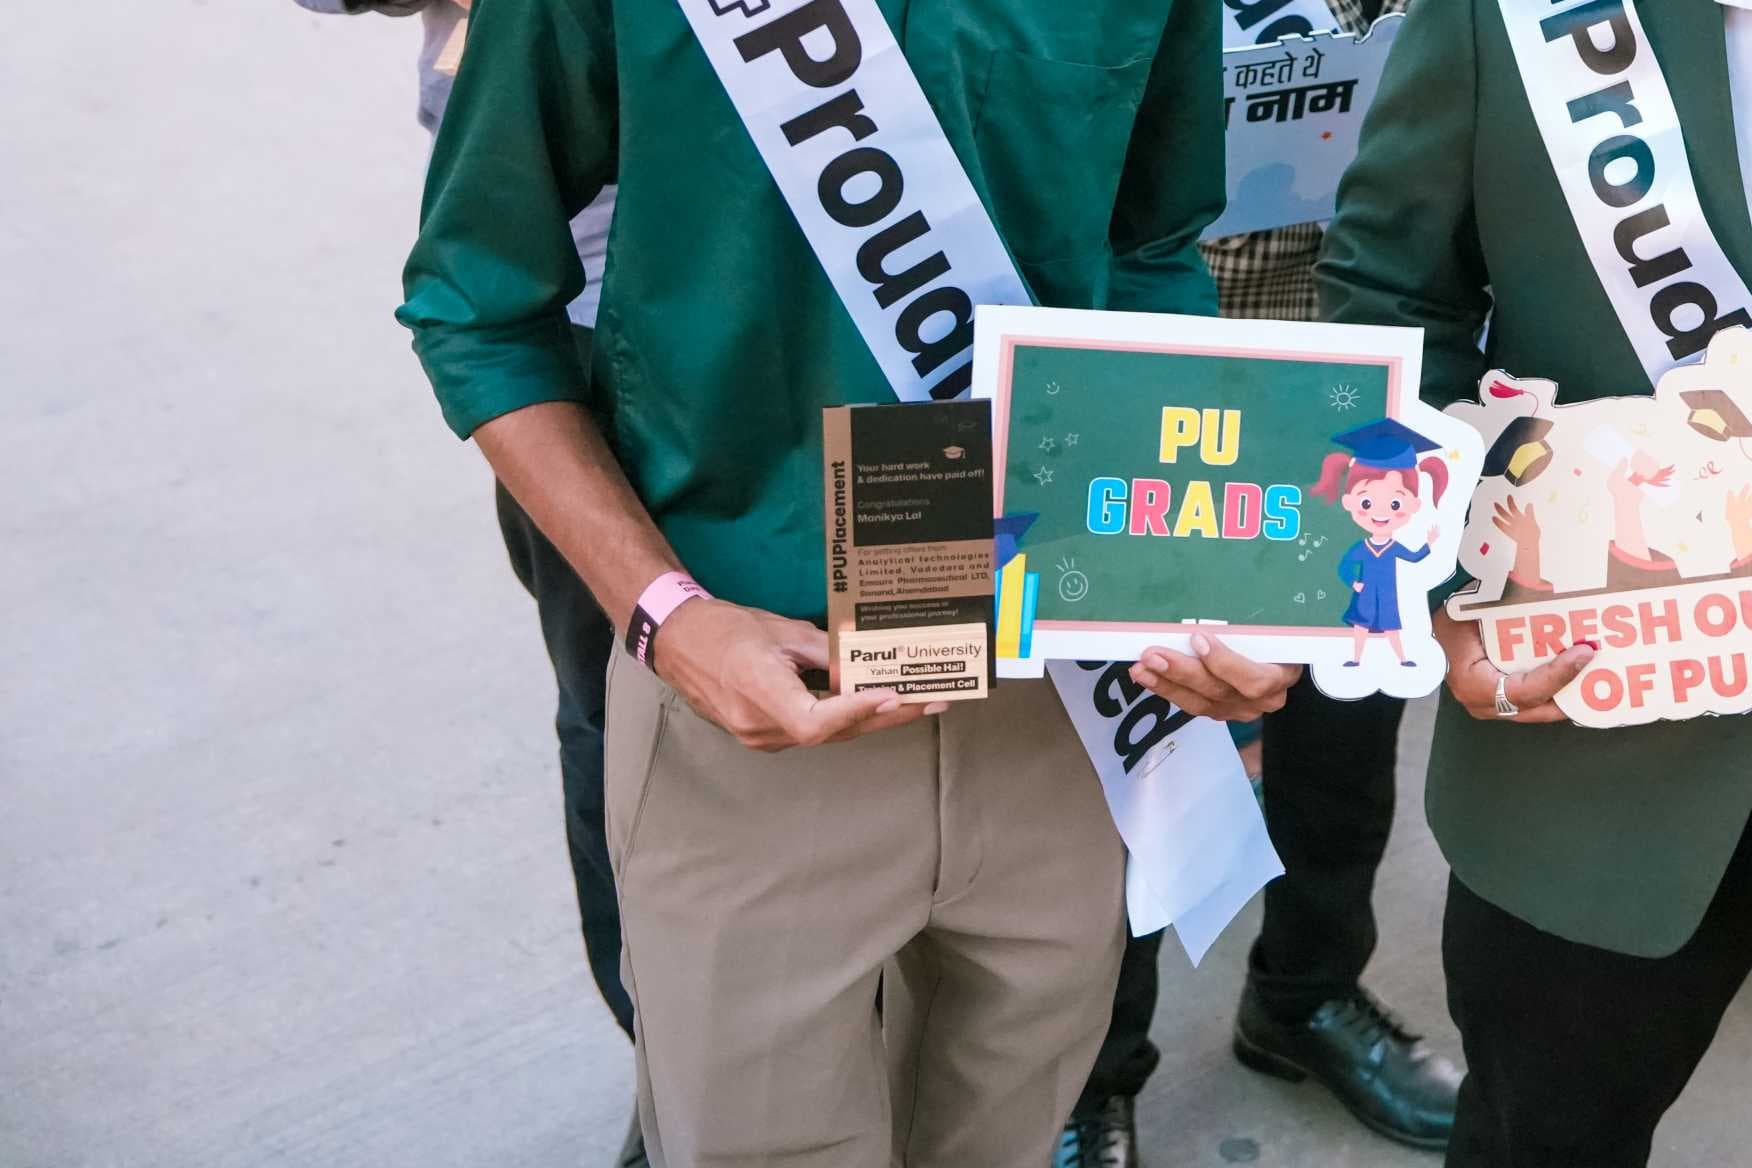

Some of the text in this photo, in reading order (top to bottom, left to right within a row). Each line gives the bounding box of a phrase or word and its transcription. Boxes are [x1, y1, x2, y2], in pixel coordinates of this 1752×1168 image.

[1159, 406, 1242, 466] PU
[858, 462, 930, 473] Your hard work
[866, 473, 918, 484] dedication
[919, 471, 943, 481] have
[944, 470, 966, 481] paid
[857, 511, 922, 523] Manikya Lal
[1087, 477, 1302, 542] GRADS
[831, 460, 848, 593] #PUPlacement
[1495, 598, 1683, 662] FRESH
[907, 643, 982, 659] University
[870, 662, 964, 676] Yahan Possible Hai!
[906, 682, 956, 692] Placement
[957, 680, 976, 688] Cell
[1580, 652, 1748, 712] OF PU
